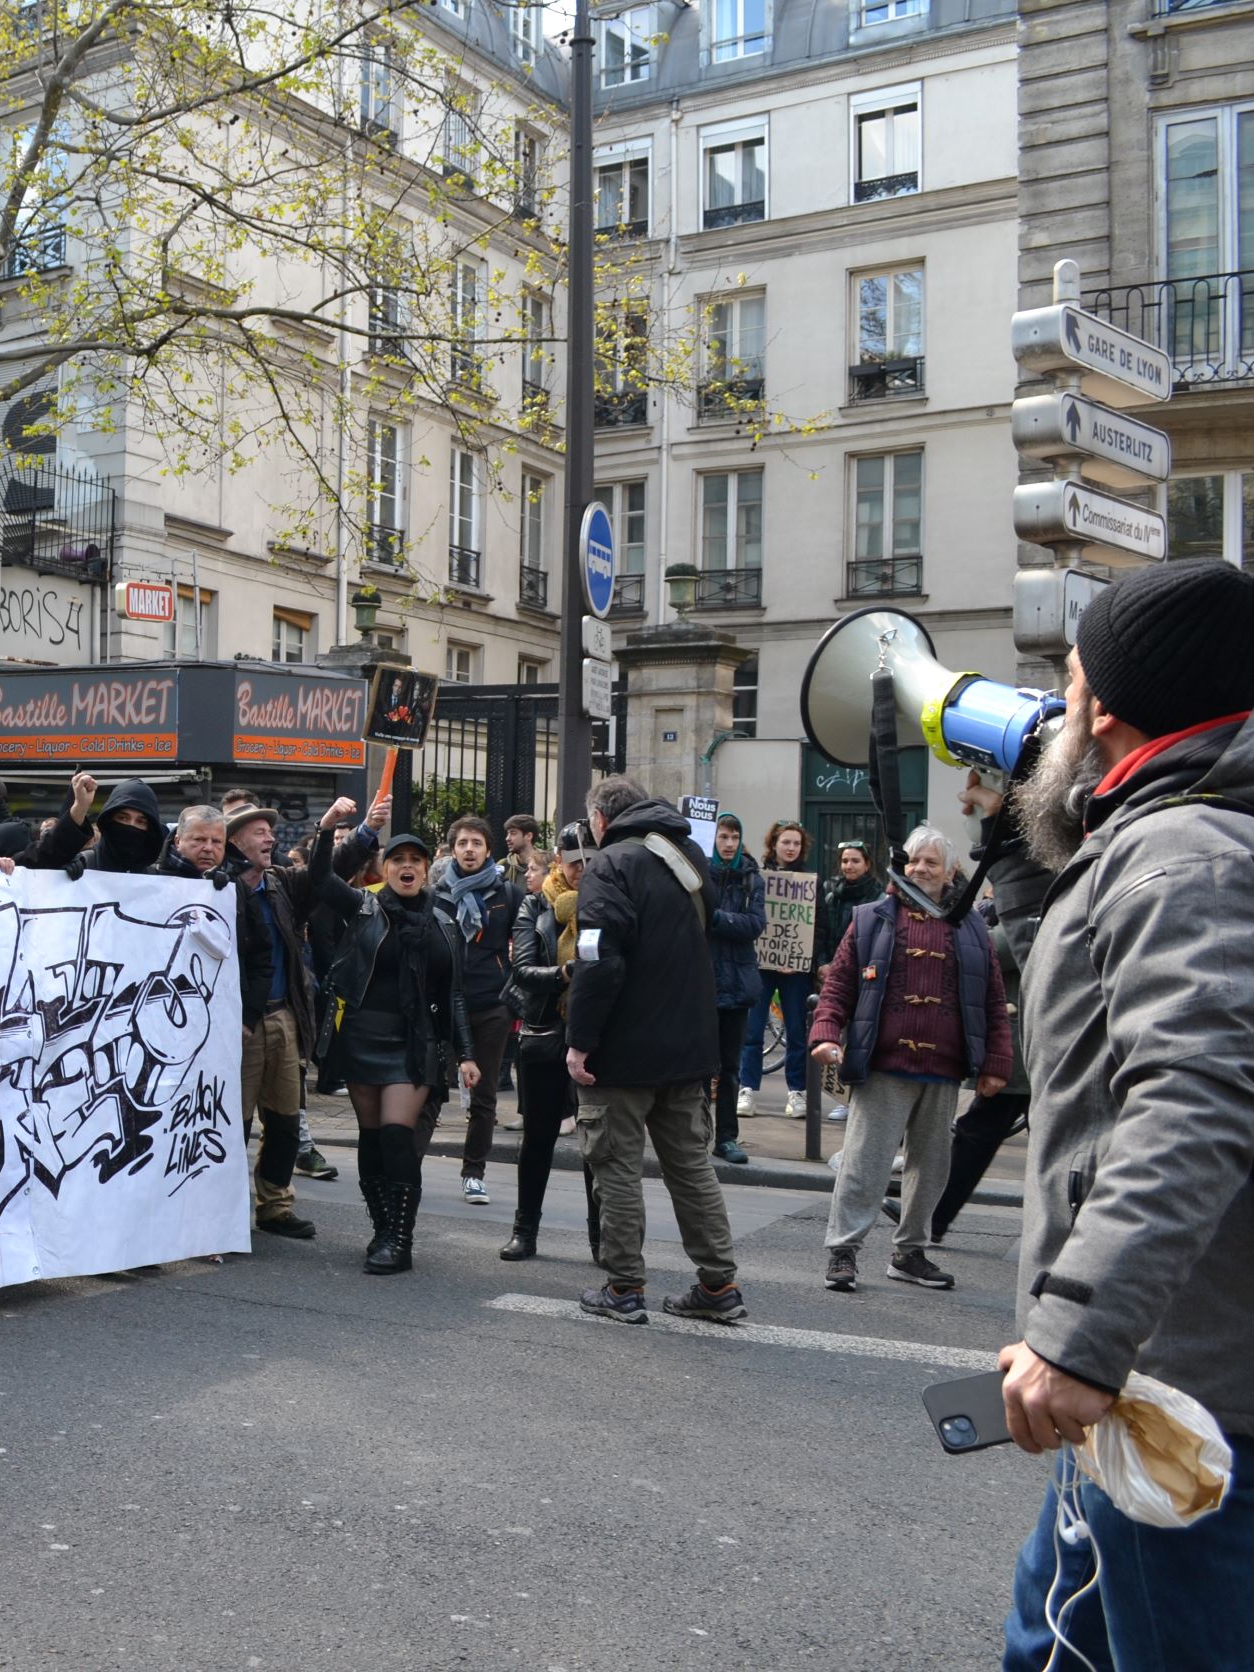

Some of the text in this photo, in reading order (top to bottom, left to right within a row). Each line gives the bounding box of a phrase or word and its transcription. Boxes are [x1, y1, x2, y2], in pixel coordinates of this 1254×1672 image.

[1087, 333, 1162, 385] GARE DE LYON
[1092, 421, 1153, 463] AUSTERLITZ
[1082, 503, 1134, 538] Commissariat
[1134, 525, 1143, 541] du
[128, 586, 171, 617] MARKET
[71, 678, 175, 728] MARKET
[236, 680, 363, 734] Bastille MARKET
[36, 738, 71, 757] Liquor
[80, 738, 106, 752] Cold
[107, 737, 145, 752] Drinks
[154, 736, 172, 751] Ice
[235, 737, 361, 760] Grocery Liquor Cold Drinks Ice
[689, 798, 716, 813] Nous
[690, 808, 713, 820] tous
[766, 876, 816, 902] FEMMES
[766, 900, 814, 925] TERRE
[772, 923, 799, 939] DES
[169, 1070, 232, 1133] BLACK
